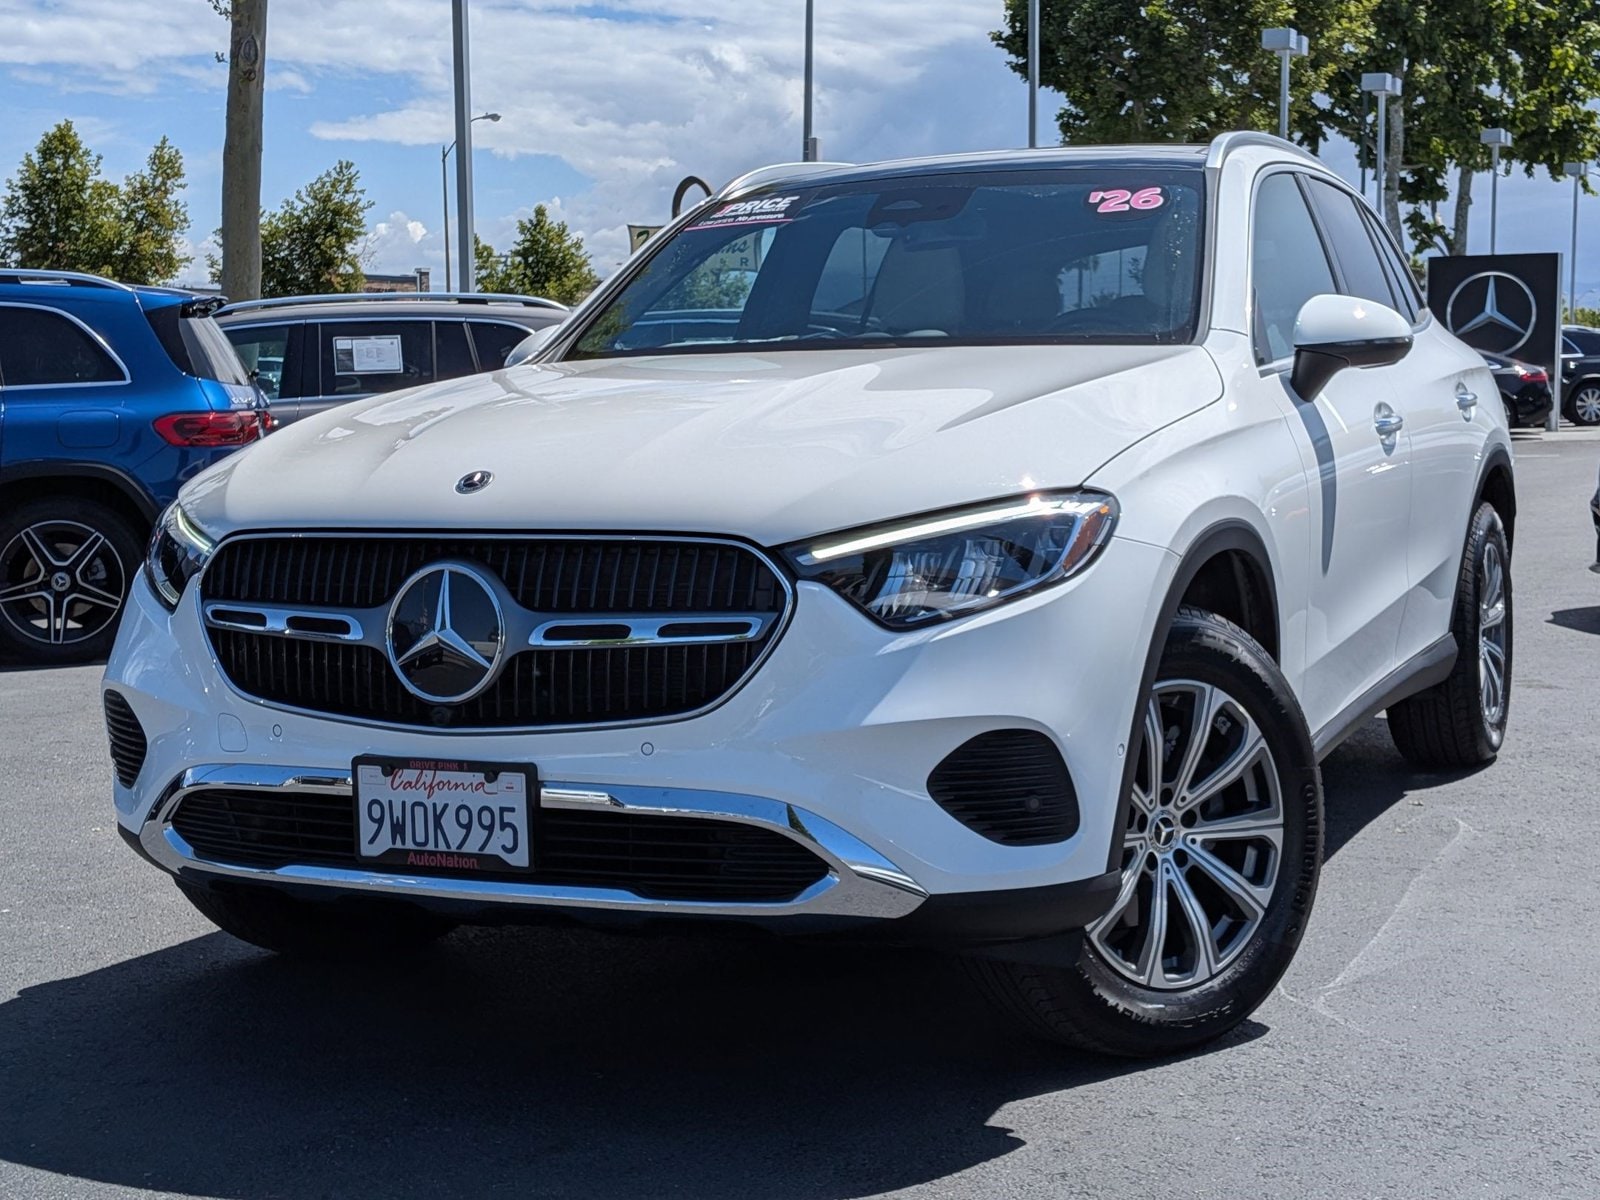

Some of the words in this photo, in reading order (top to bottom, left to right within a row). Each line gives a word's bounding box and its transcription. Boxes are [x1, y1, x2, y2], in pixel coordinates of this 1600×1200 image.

[1088, 187, 1164, 213] '26
[409, 760, 436, 770] DRIVE
[437, 761, 459, 771] PINK
[390, 768, 498, 799] California
[367, 799, 519, 854] 9WOK995
[407, 851, 478, 869] AutoNation
